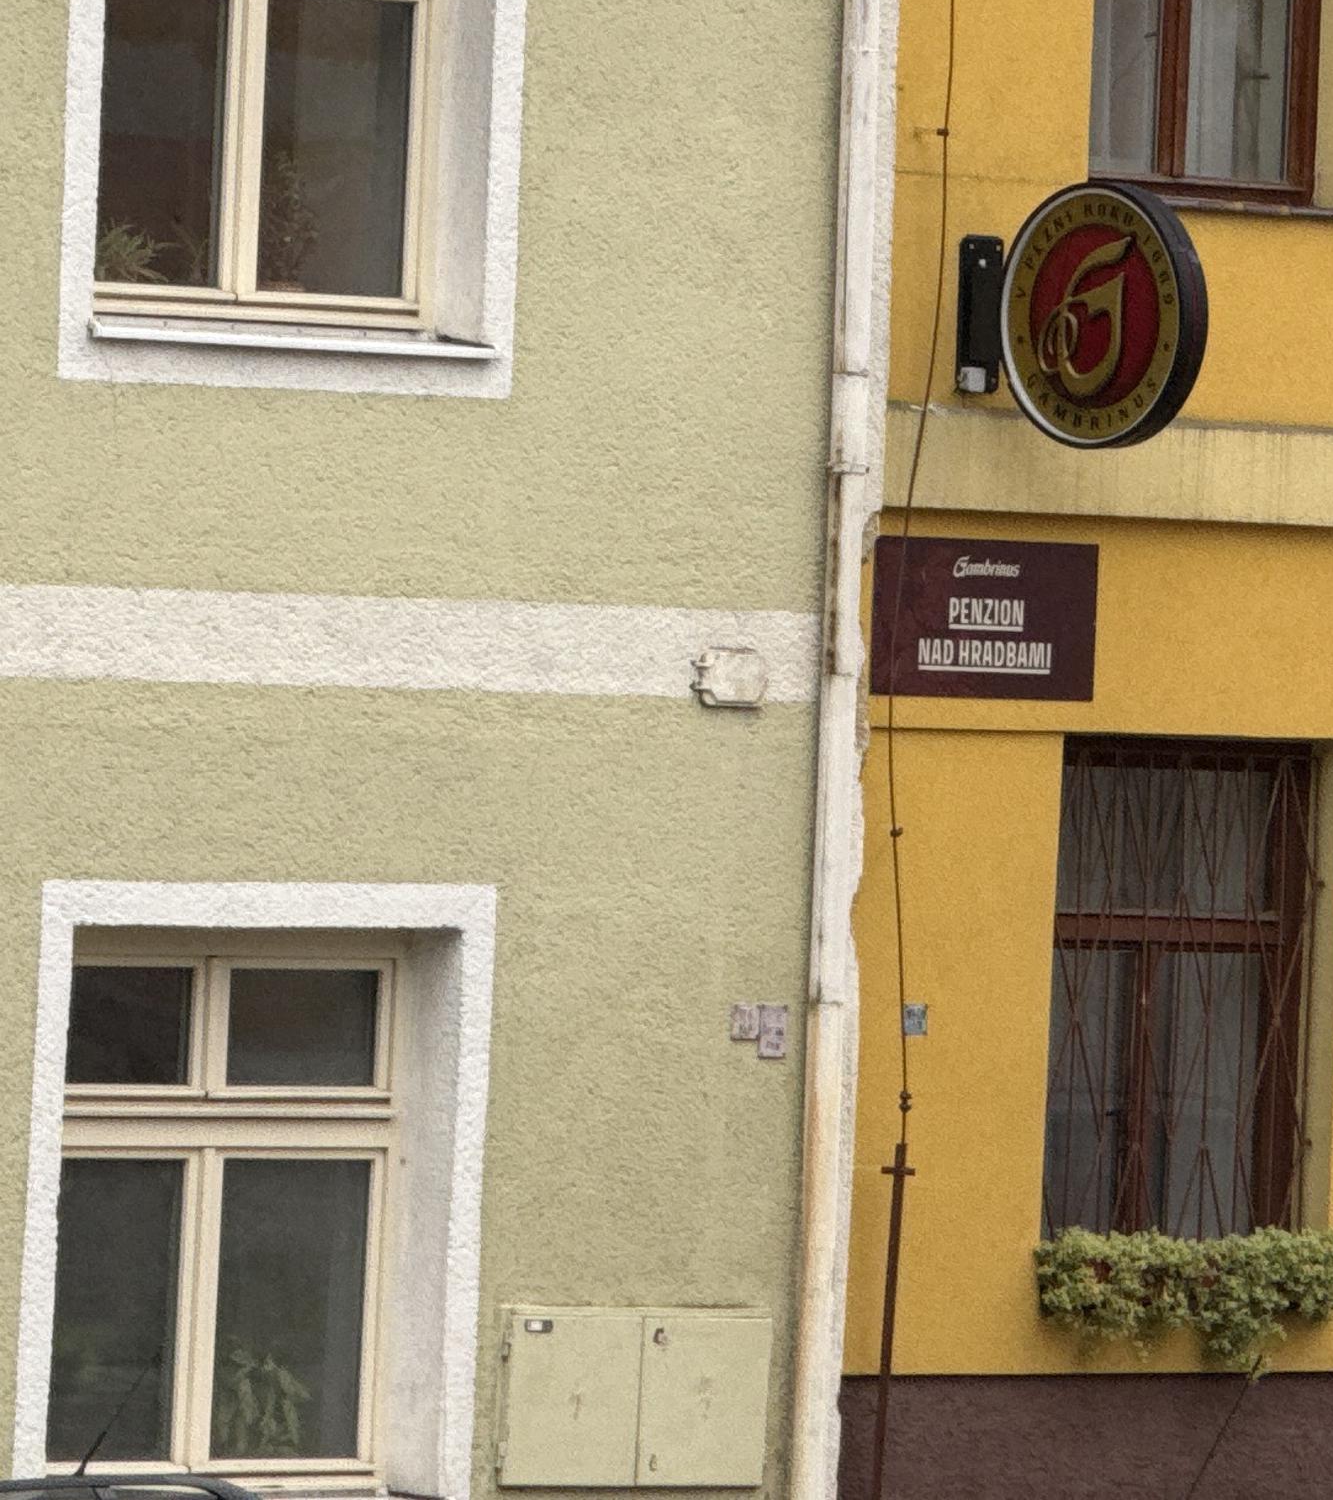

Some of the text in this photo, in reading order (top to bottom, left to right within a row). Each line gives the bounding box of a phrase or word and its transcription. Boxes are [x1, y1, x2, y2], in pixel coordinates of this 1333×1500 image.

[1026, 373, 1157, 431] GAMBRINUS
[952, 555, 1022, 578] Gambrinus
[949, 596, 1024, 626] PENZION
[917, 638, 1052, 668] NAD HRADBAMI
